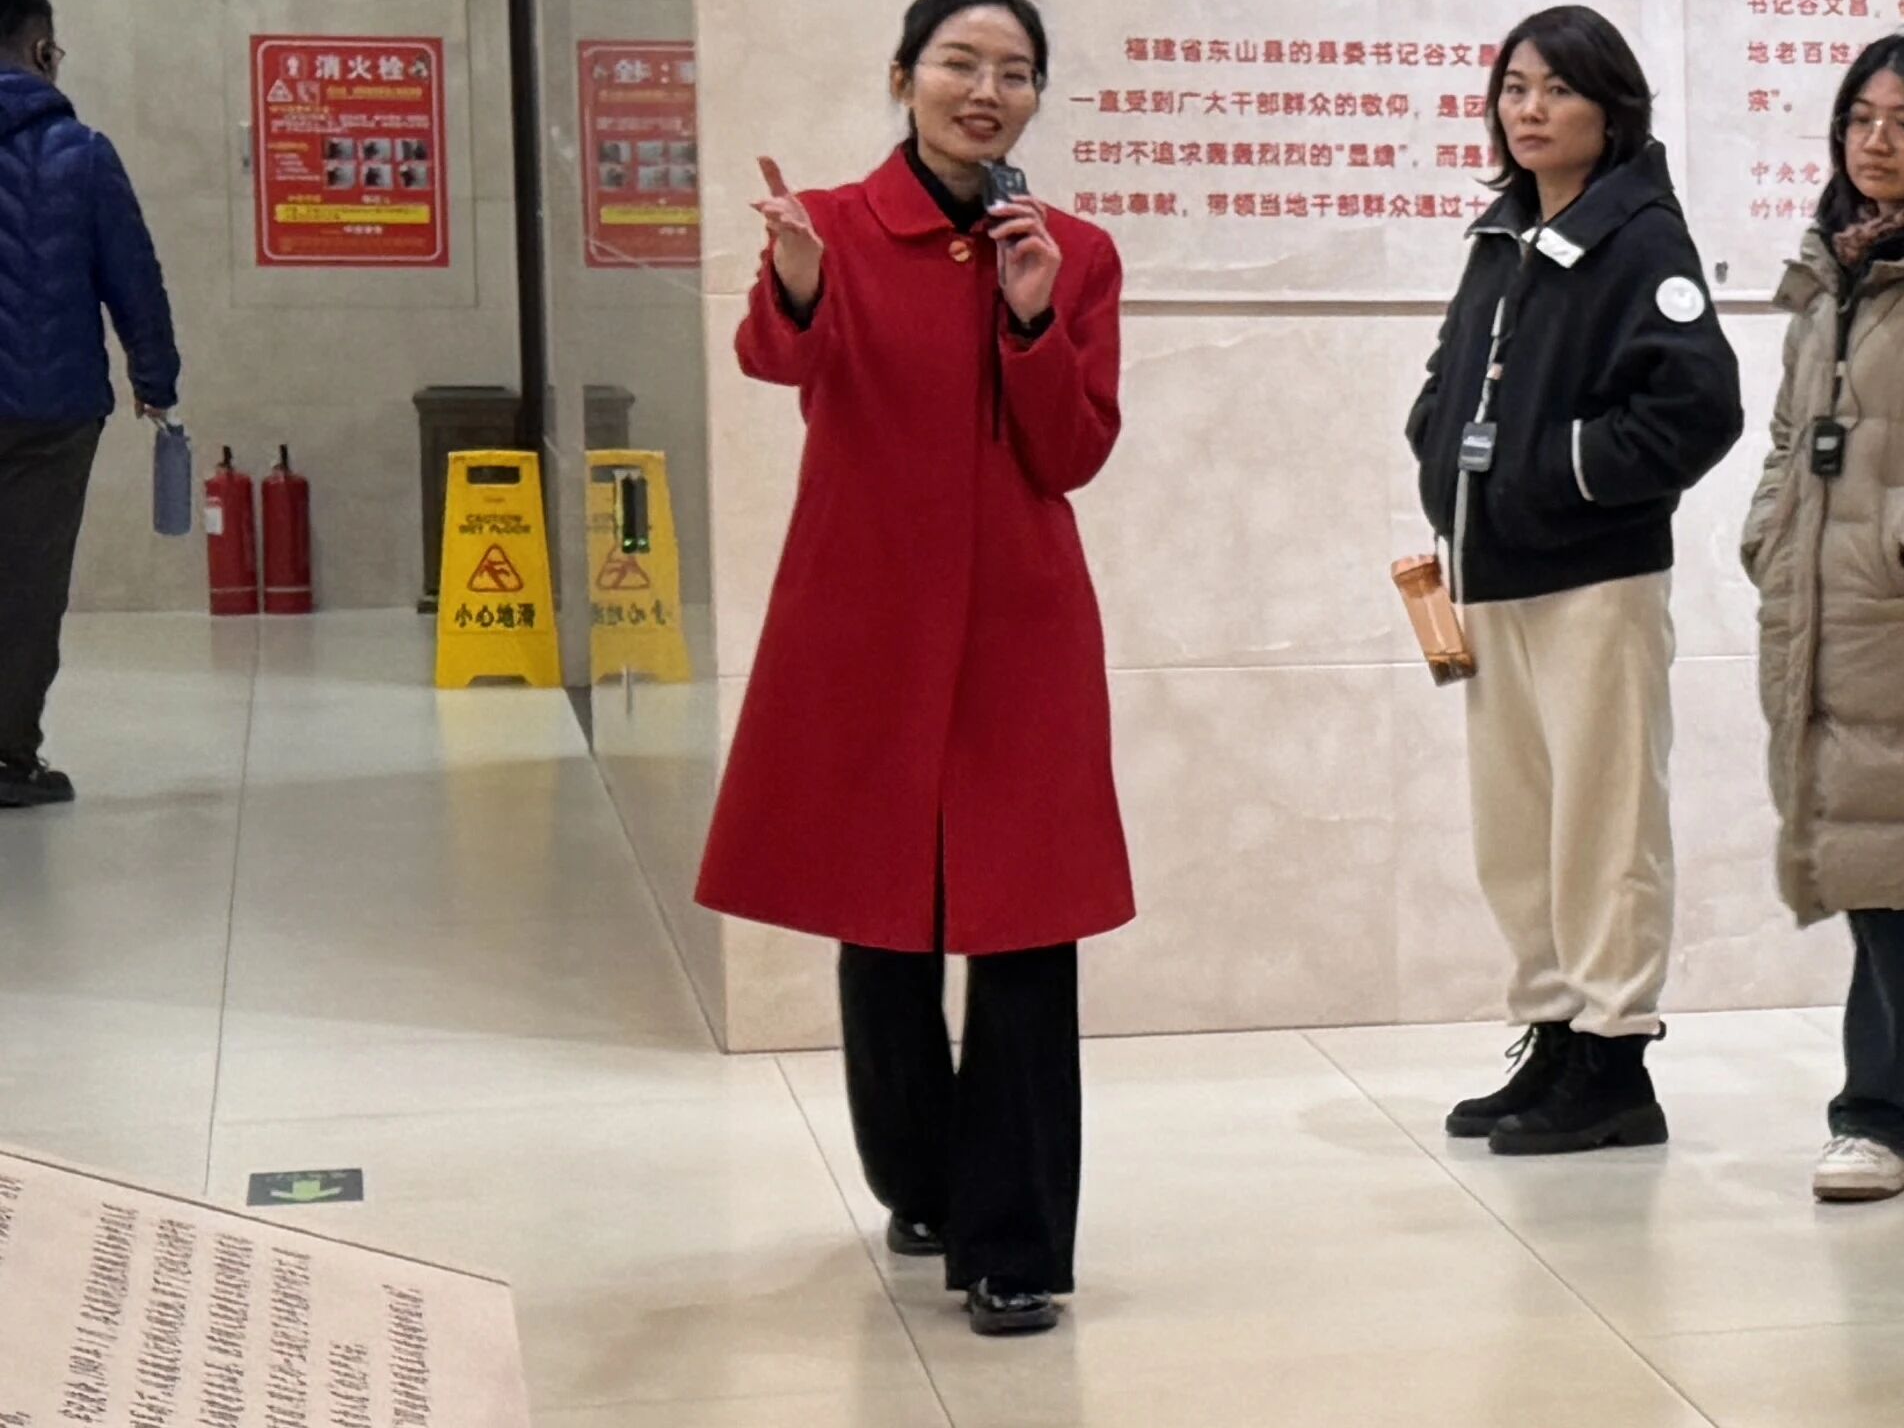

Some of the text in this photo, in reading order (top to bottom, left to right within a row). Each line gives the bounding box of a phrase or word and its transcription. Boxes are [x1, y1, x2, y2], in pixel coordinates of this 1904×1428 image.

[315, 54, 405, 82] 消火栓
[454, 602, 536, 629] 小心地滑
